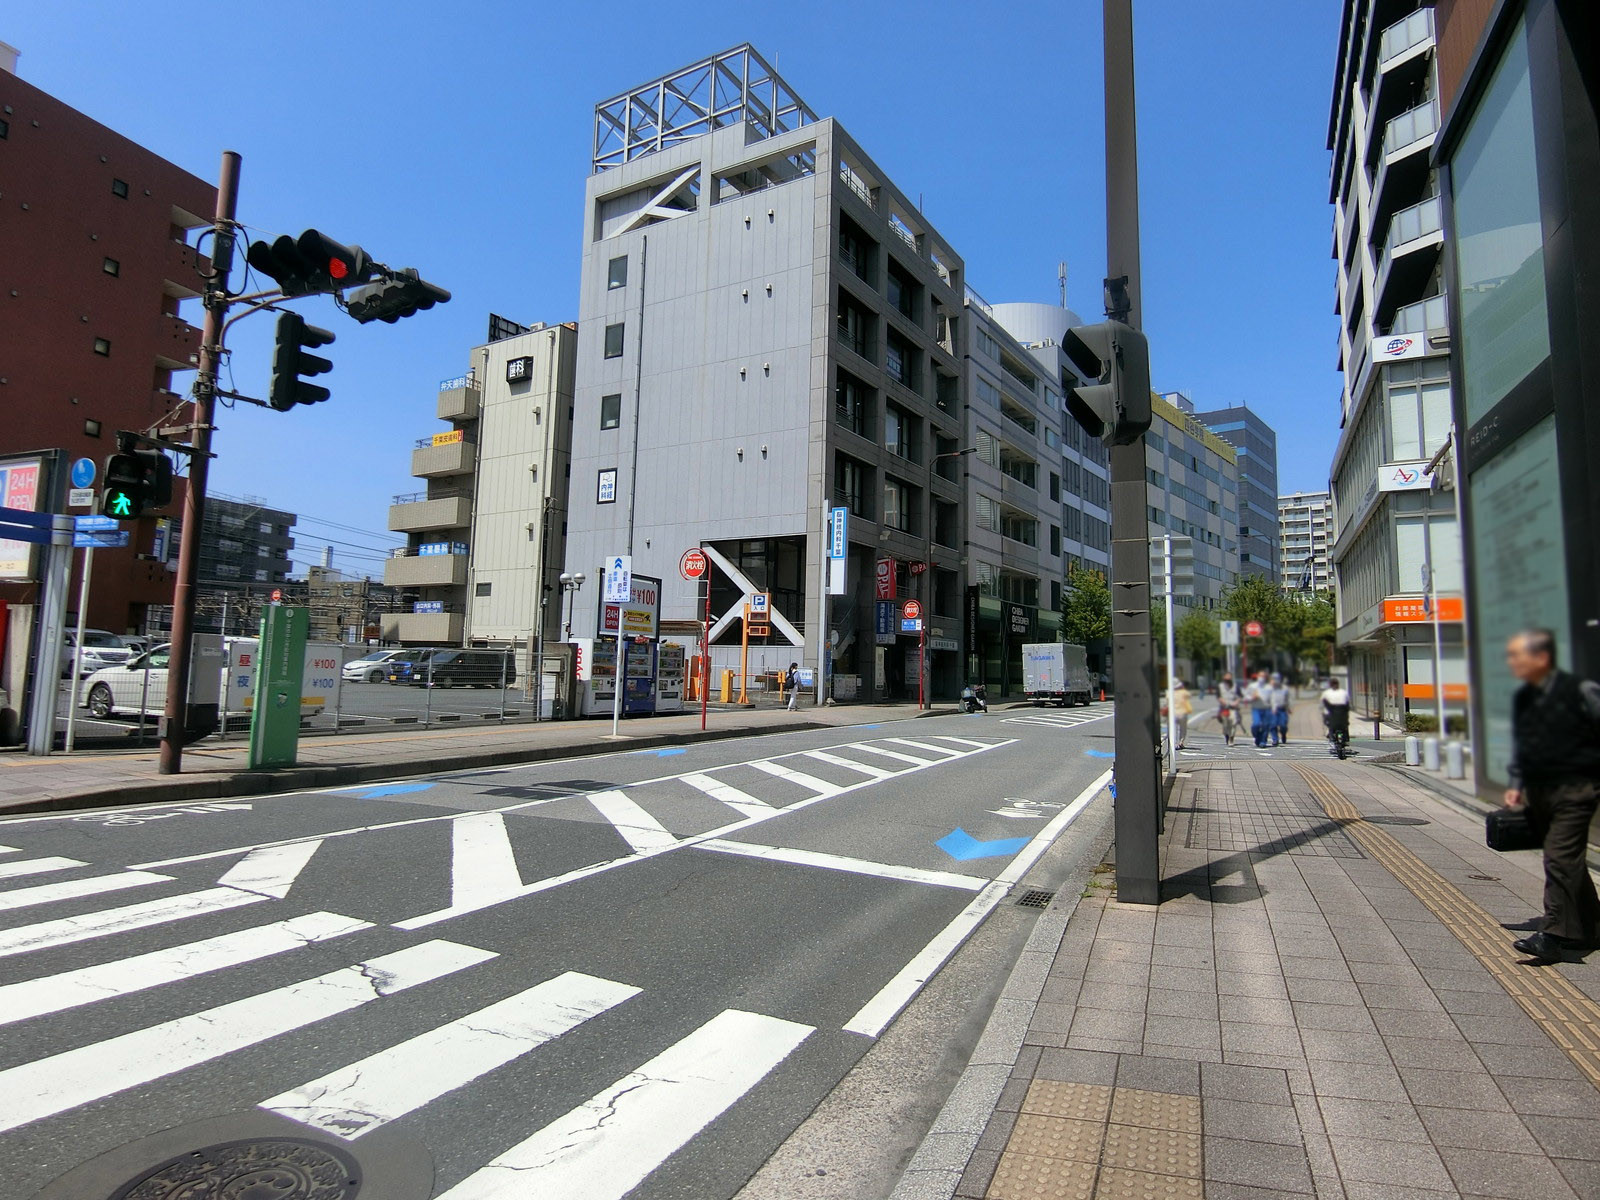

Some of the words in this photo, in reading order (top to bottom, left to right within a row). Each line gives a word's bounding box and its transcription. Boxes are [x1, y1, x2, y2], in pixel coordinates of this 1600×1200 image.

[509, 359, 525, 378] 歯科
[440, 377, 466, 391] 弁天歯科
[10, 473, 36, 492] 24H
[685, 560, 704, 570] 消火栓
[637, 589, 656, 606] ¥100
[606, 609, 619, 619] 24H
[1011, 606, 1024, 615] CHIBA
[606, 619, 619, 627] OPEN
[1011, 615, 1030, 626] DESIGNER
[239, 654, 251, 667] 昼
[313, 659, 336, 669] ¥100
[237, 675, 250, 688] 夜
[312, 678, 334, 689] ¥100
